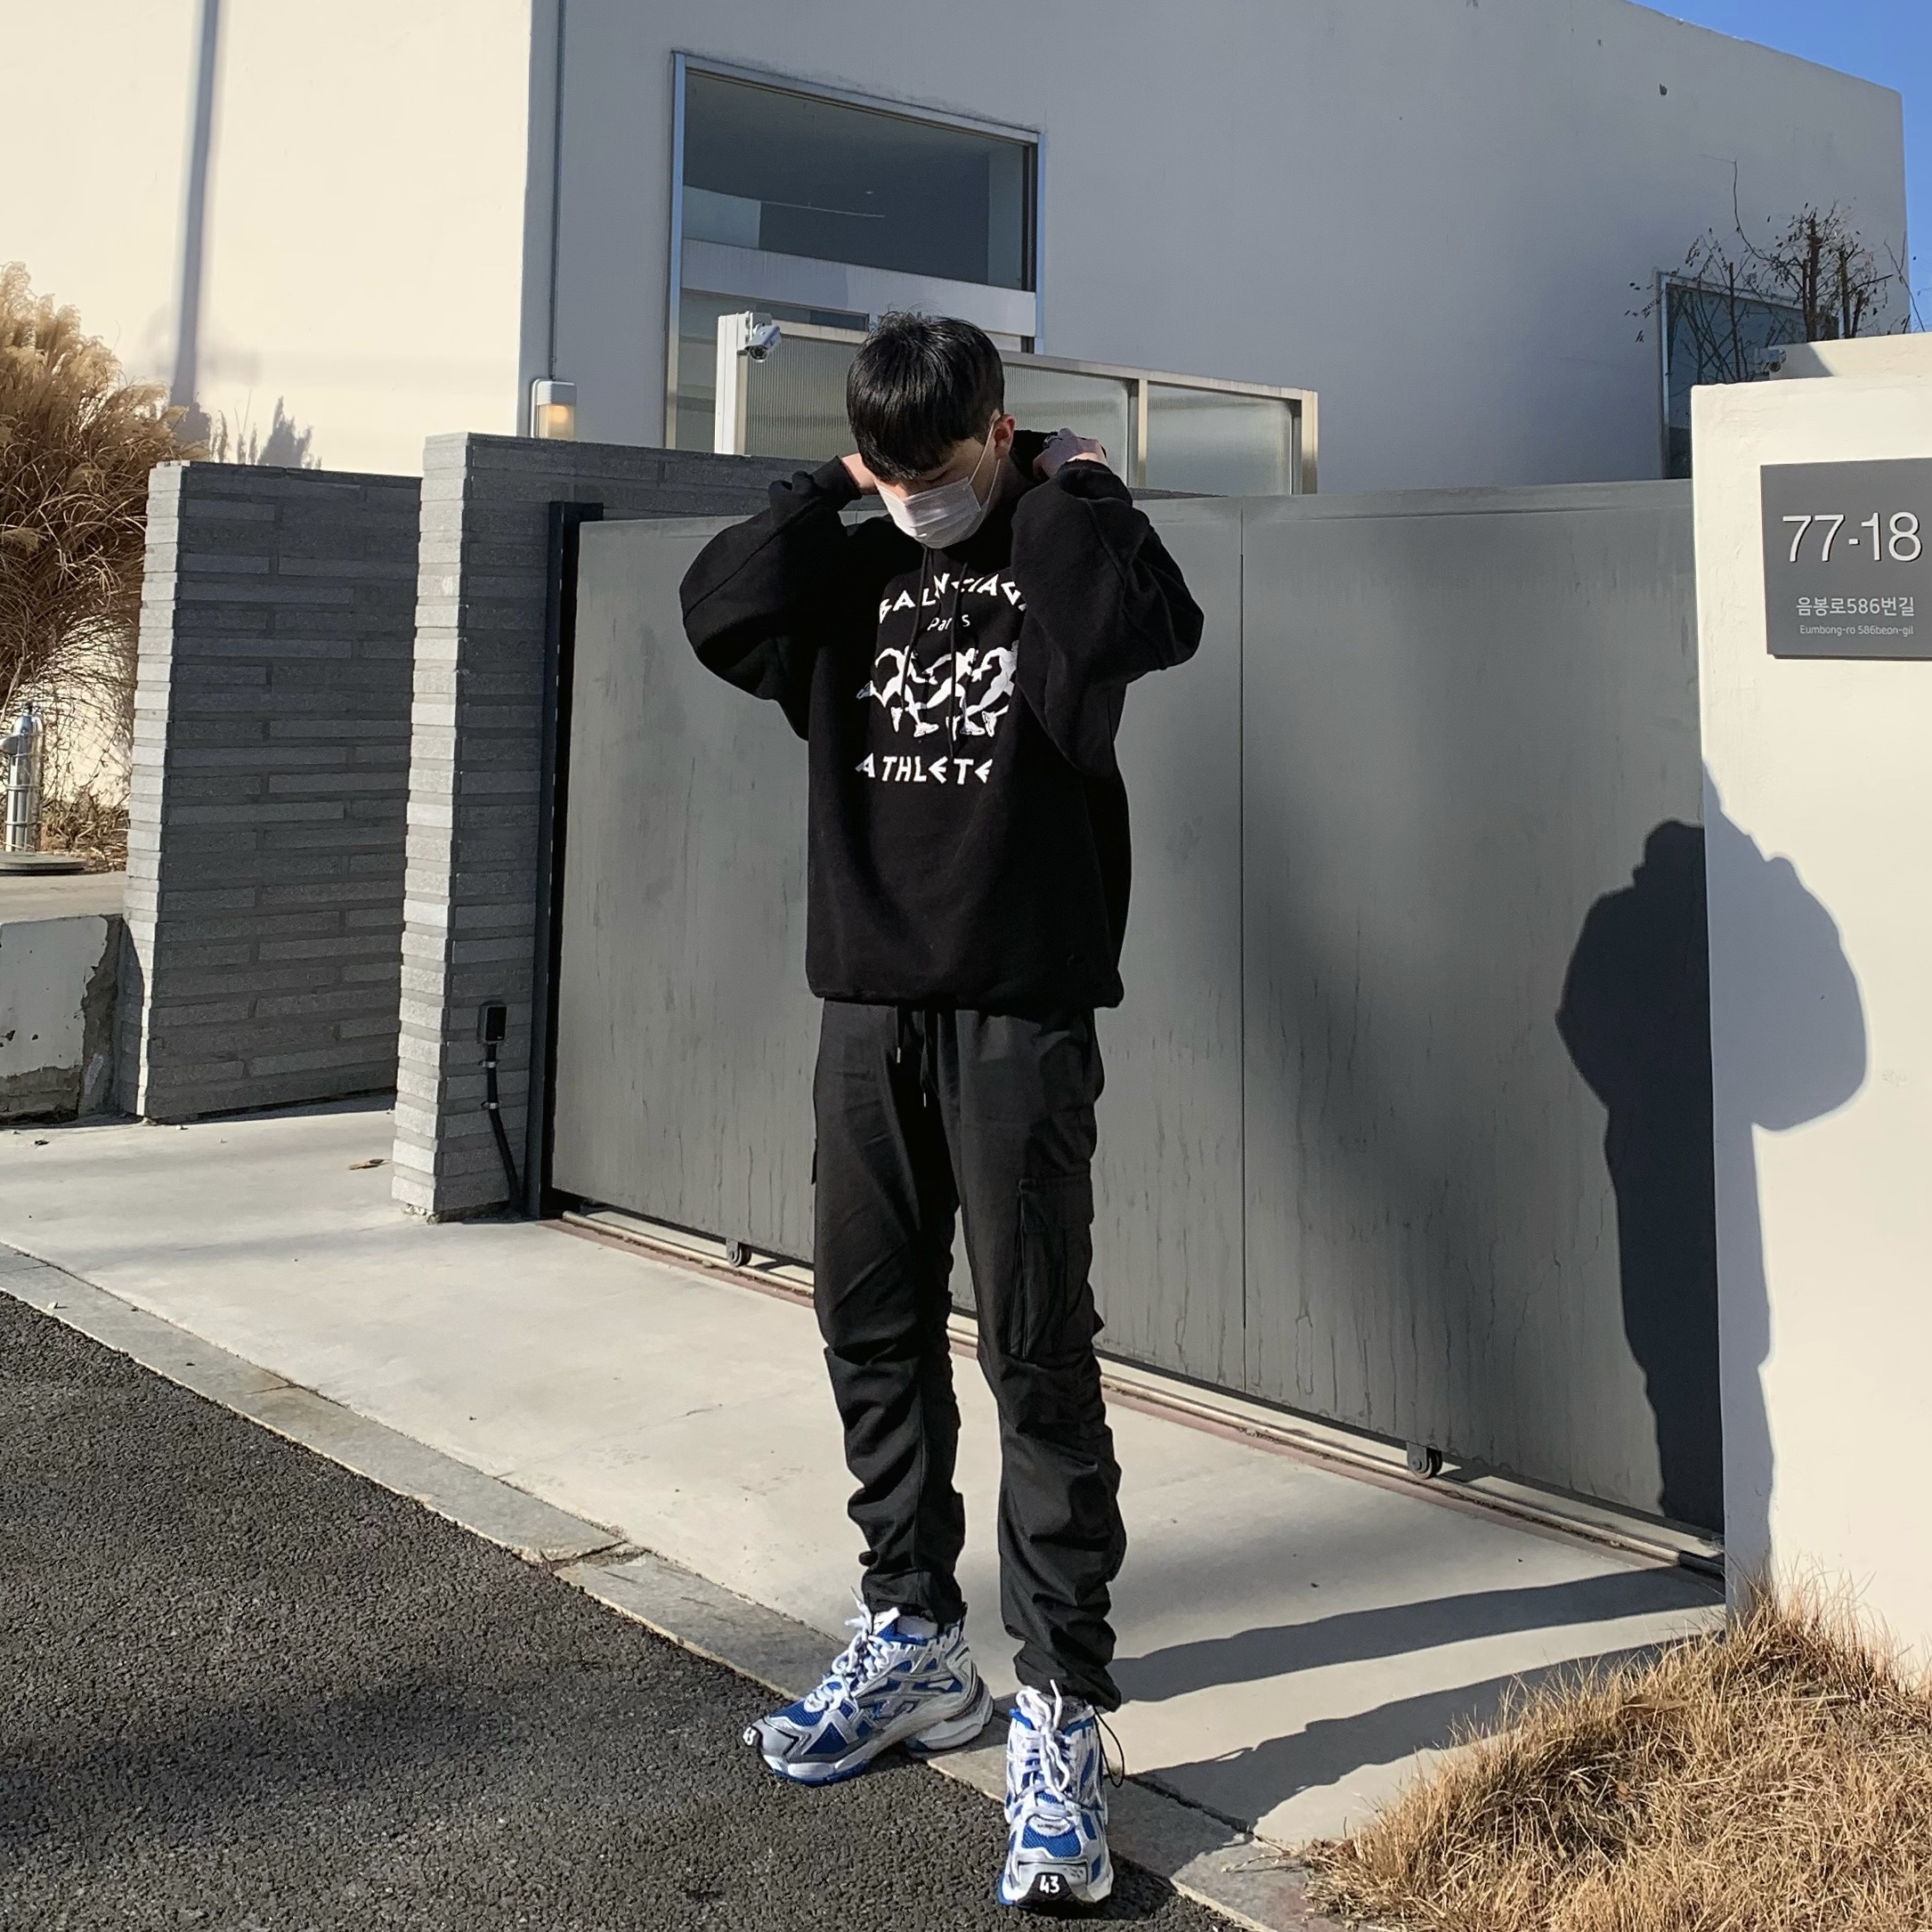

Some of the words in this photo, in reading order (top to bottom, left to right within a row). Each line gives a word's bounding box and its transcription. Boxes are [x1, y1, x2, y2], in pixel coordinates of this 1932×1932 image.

[1782, 512, 1922, 562] 77-18
[1796, 597, 1915, 617] 음봉로586번길
[927, 614, 970, 631] Pars
[1799, 625, 1856, 637] Eumbong-ro
[1857, 625, 1914, 637] 586beon-gil
[855, 752, 994, 785] ATHLETE
[1039, 1874, 1060, 1894] 43
